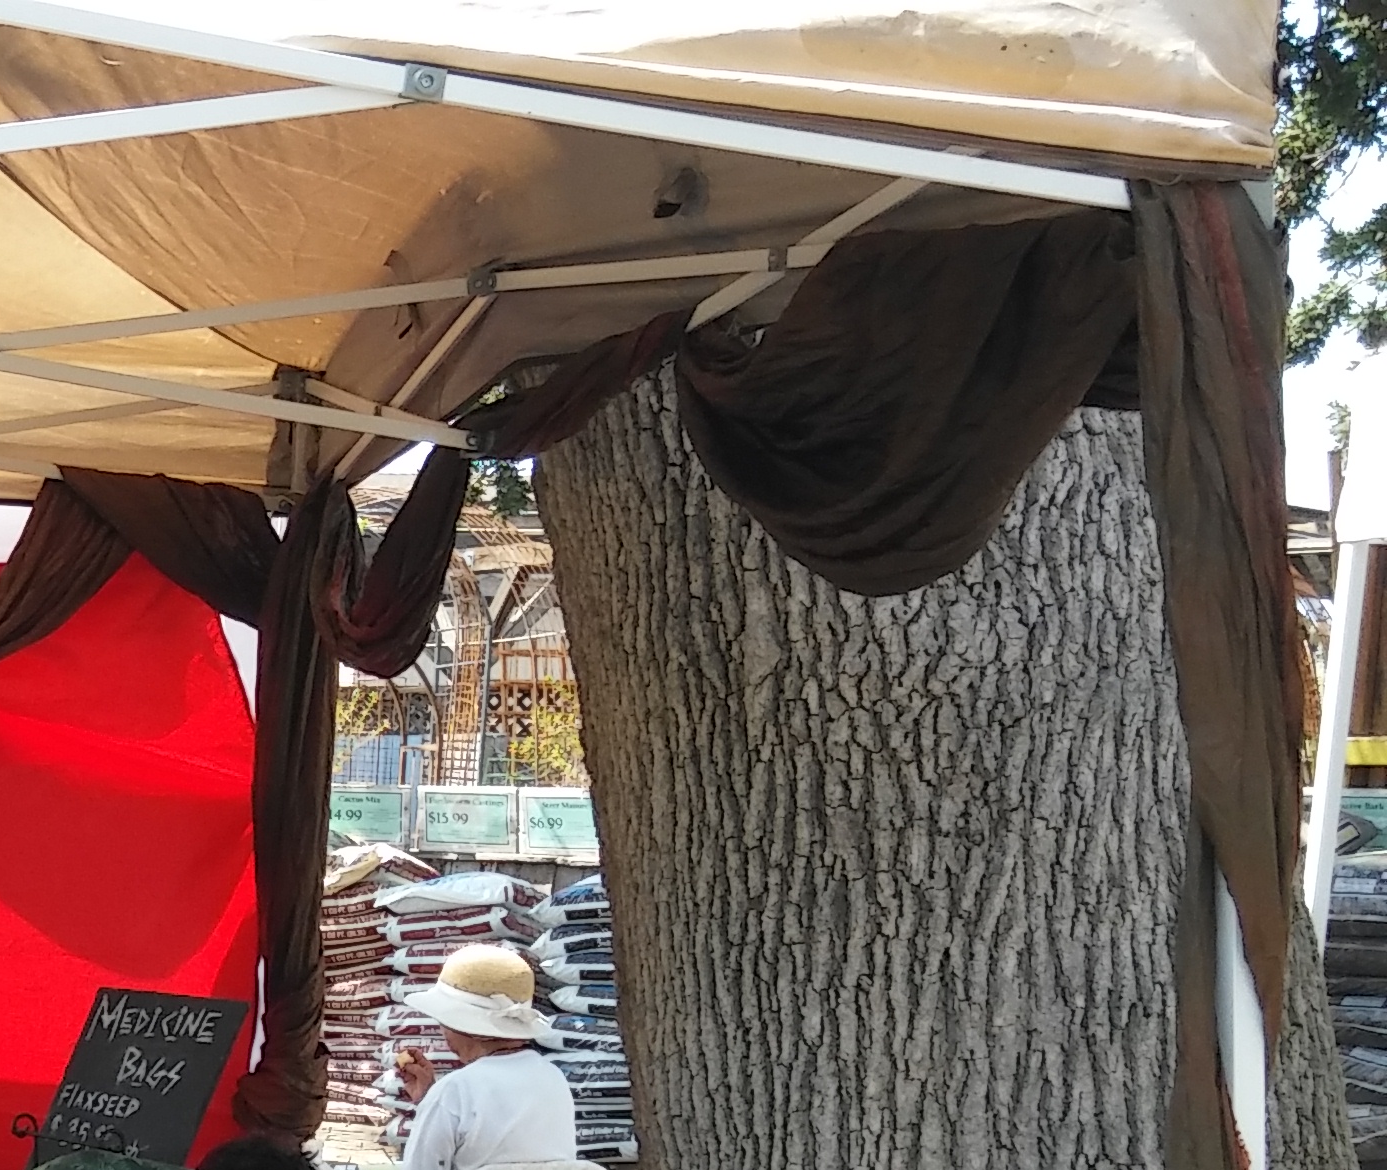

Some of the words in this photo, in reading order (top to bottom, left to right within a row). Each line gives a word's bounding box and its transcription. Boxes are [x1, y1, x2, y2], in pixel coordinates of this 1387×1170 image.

[529, 816, 563, 830] $6.99
[86, 993, 222, 1044] MEDICINE
[116, 1046, 186, 1096] BAGS
